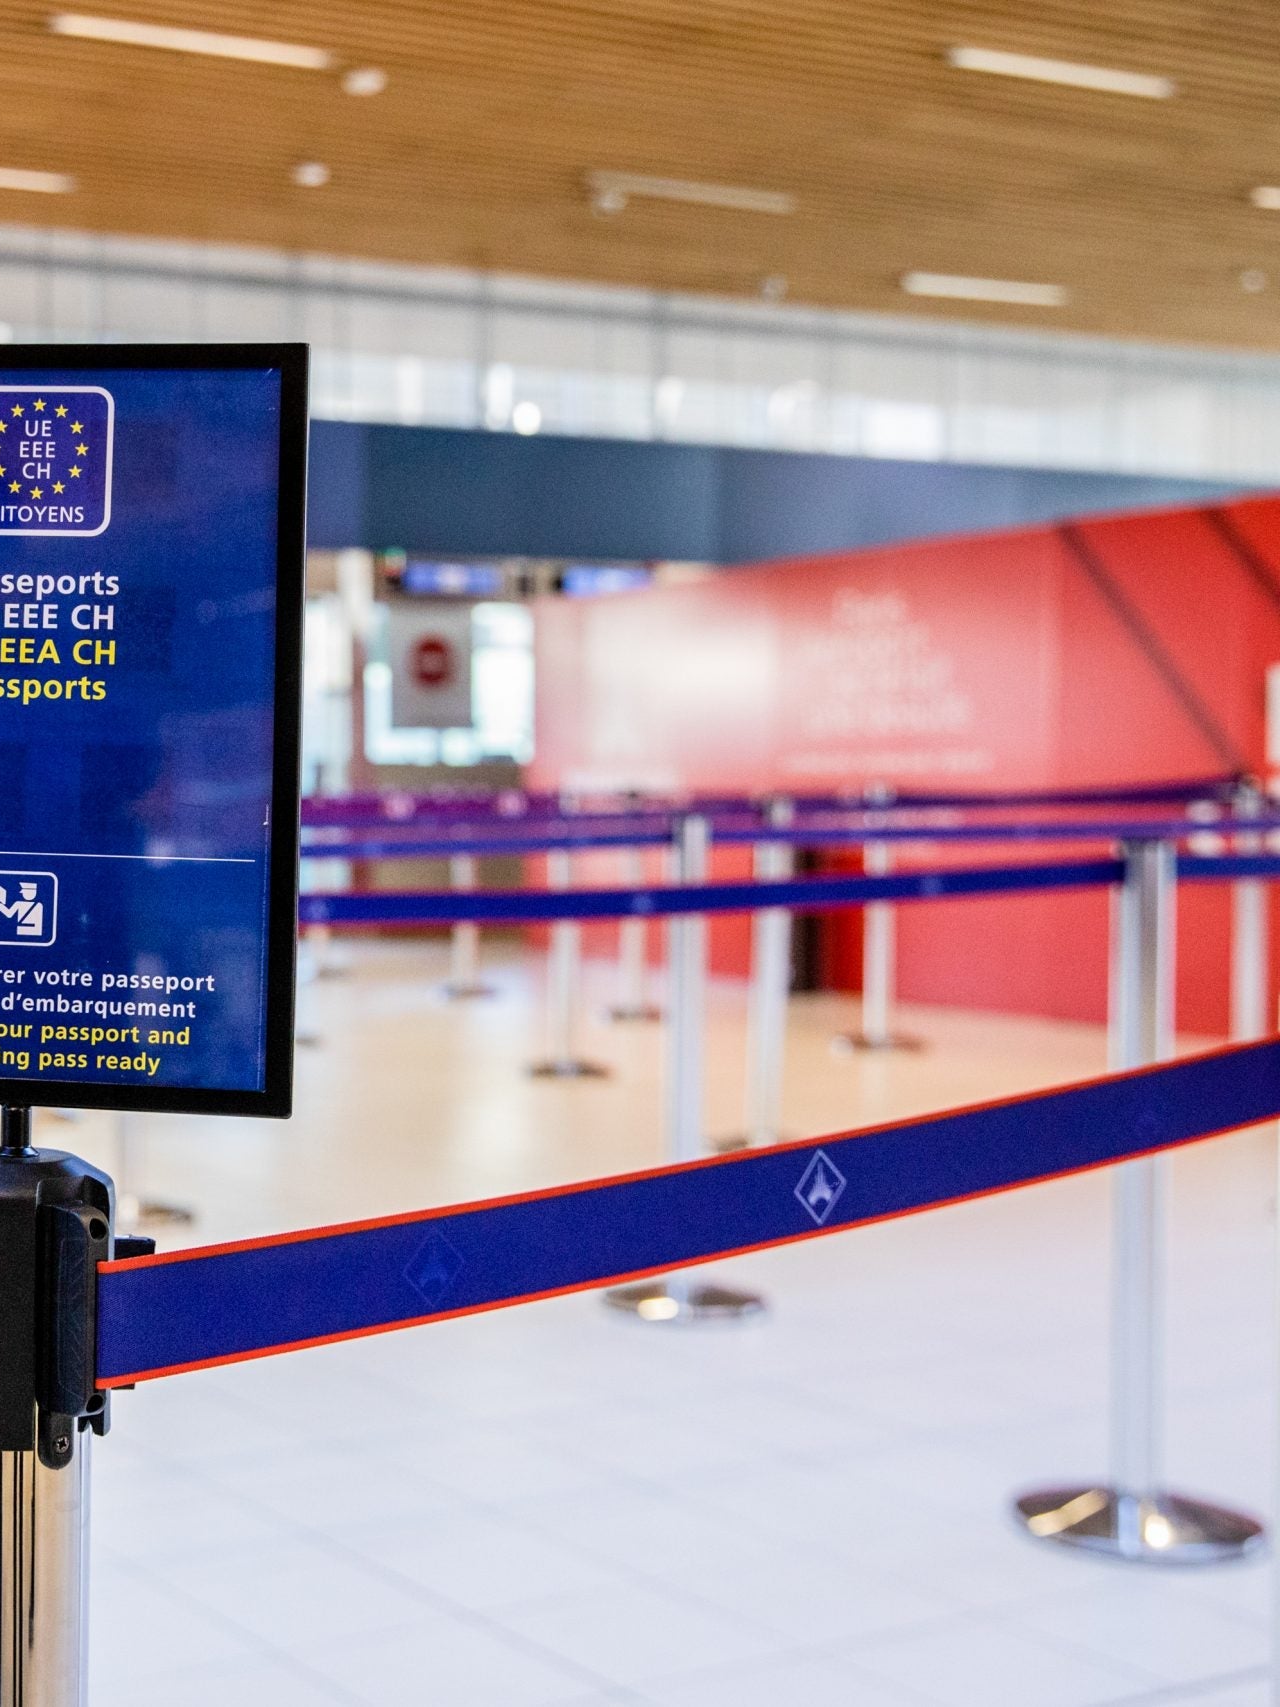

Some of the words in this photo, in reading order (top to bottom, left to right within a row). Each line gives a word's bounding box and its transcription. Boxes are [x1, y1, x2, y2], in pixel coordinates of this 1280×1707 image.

[25, 419, 52, 437] UE
[19, 440, 56, 459] EEE
[22, 462, 51, 480] CH
[4, 603, 59, 629] EEE
[71, 603, 114, 630] CH
[0, 637, 61, 664] EEA
[72, 639, 116, 665] CH
[33, 969, 93, 987] votre
[101, 973, 215, 995] passeport
[1, 991, 196, 1020] d’embarquement
[40, 1025, 140, 1047] passport
[147, 1026, 190, 1046] and
[38, 1052, 88, 1071] pass
[96, 1051, 161, 1077] ready
